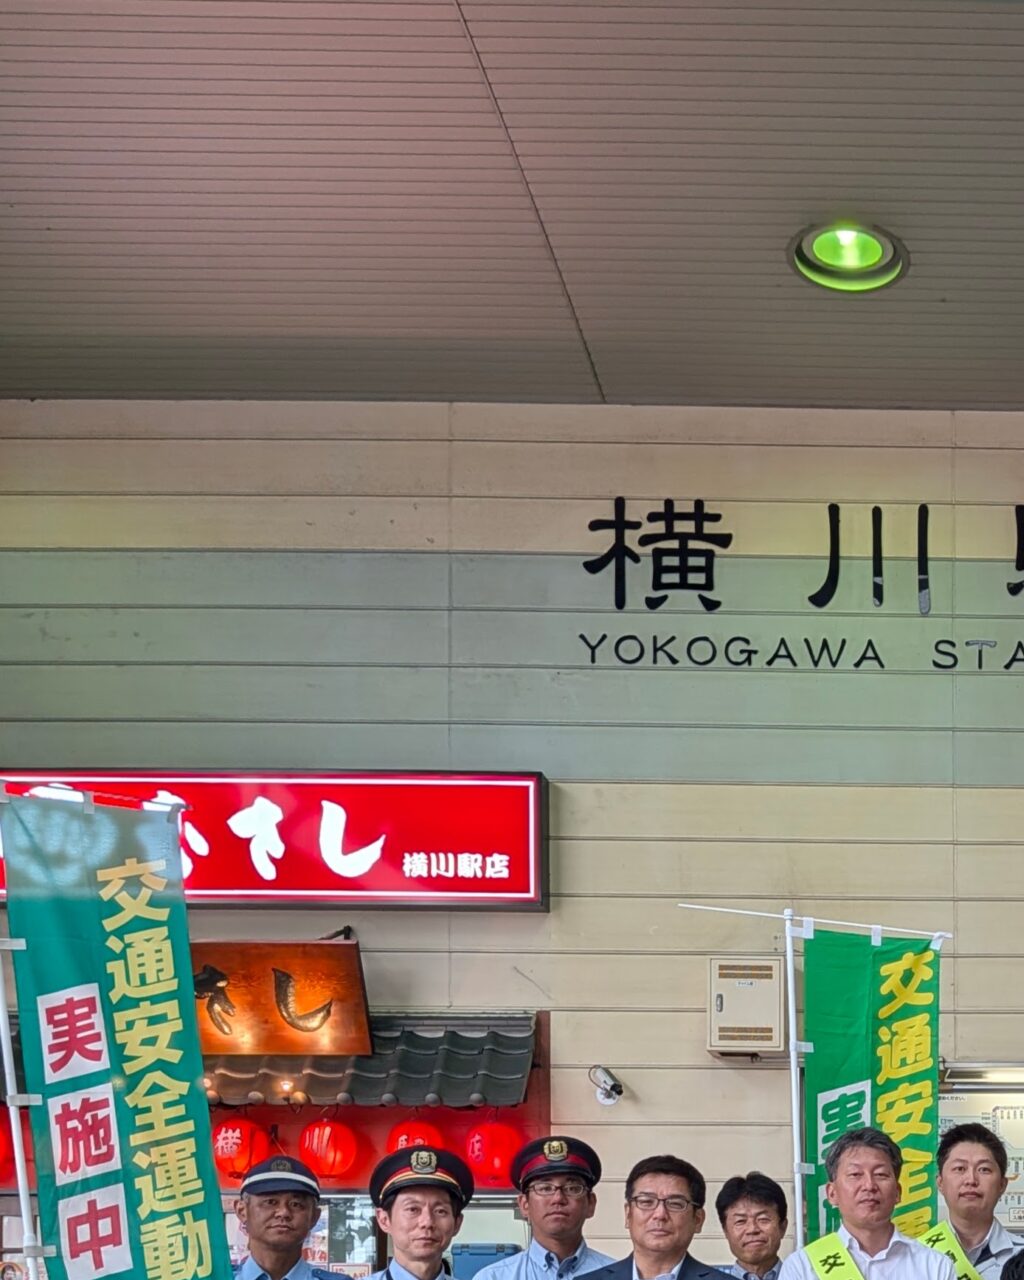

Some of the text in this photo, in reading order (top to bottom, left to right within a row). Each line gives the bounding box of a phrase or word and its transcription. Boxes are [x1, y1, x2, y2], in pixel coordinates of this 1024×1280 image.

[579, 633, 886, 669] YOKOGAWA
[402, 852, 510, 879] 横川駅店
[44, 995, 123, 1271] 実施中
